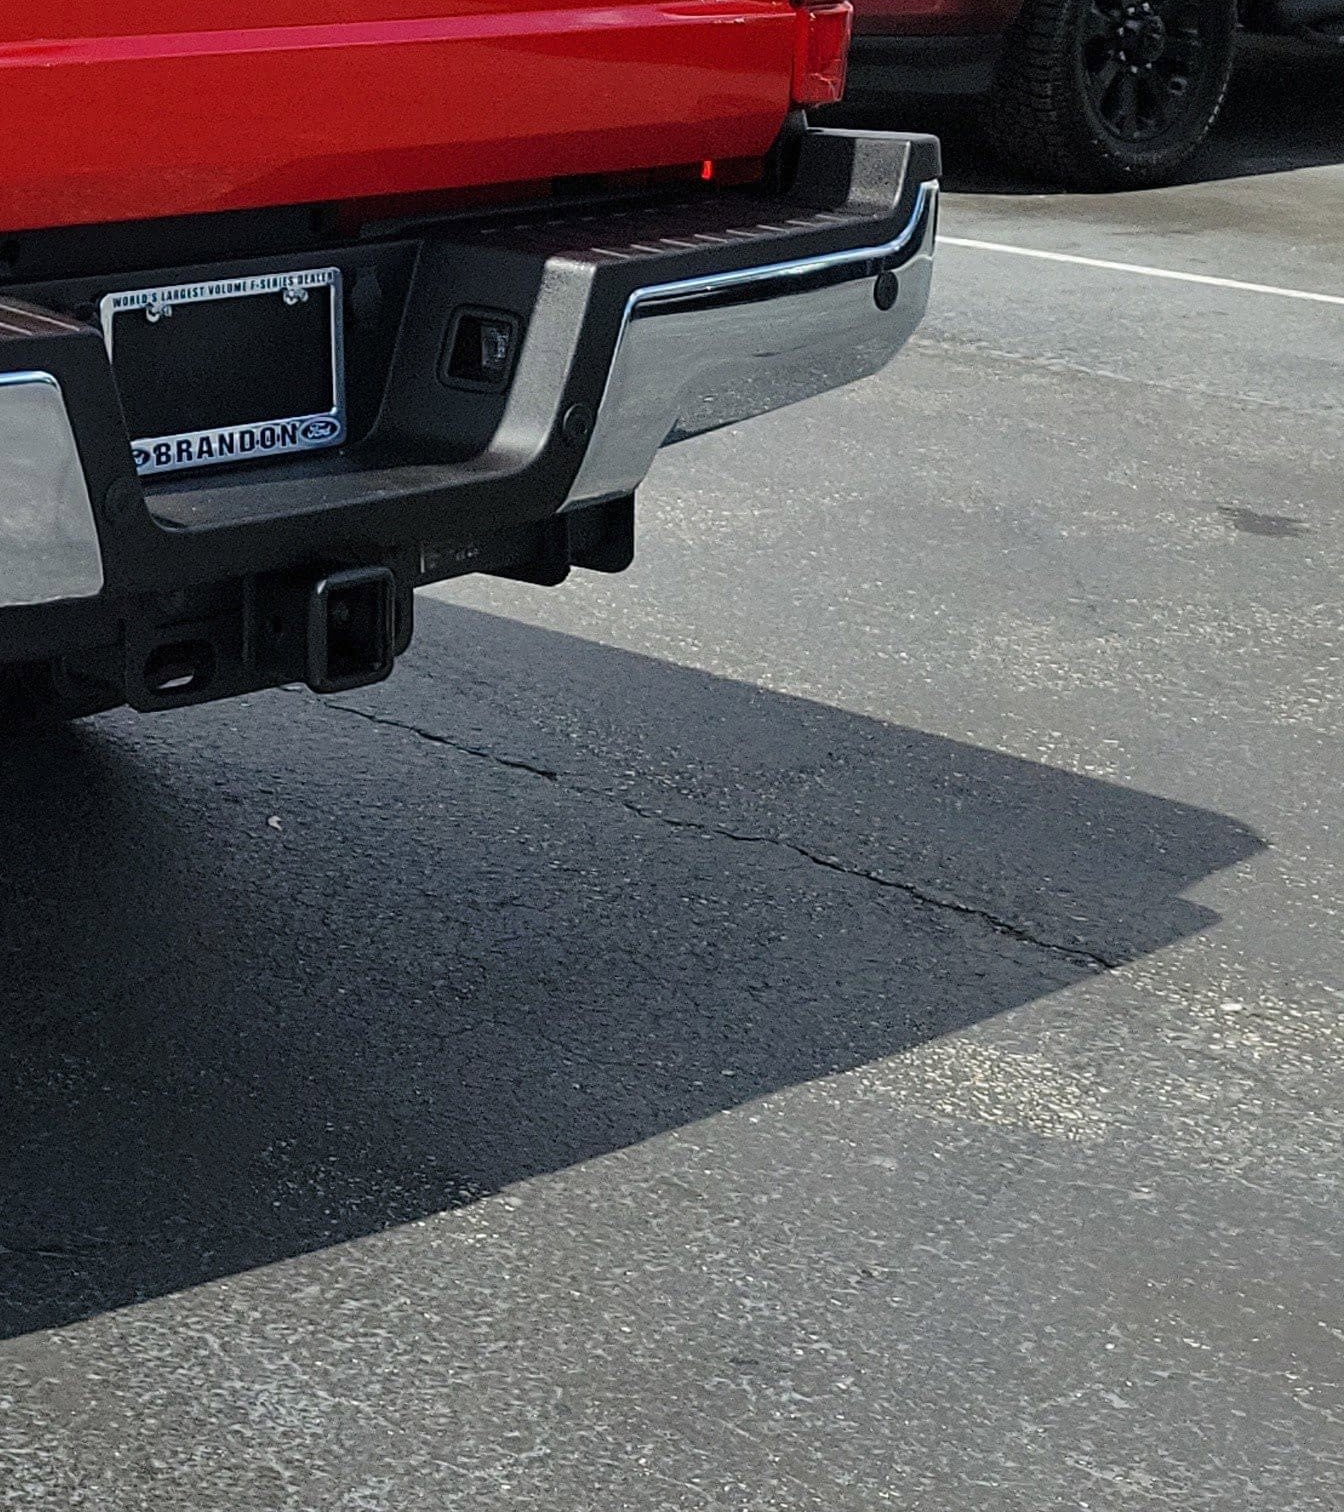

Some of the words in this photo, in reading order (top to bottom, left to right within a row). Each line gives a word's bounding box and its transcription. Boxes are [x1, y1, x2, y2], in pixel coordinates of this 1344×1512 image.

[112, 292, 158, 308] WORLD'S
[160, 286, 205, 302] LARGEST
[208, 281, 248, 297] VOLUME
[250, 275, 294, 292] F-SERIES
[297, 271, 334, 286] DEALER
[153, 422, 299, 466] BRANDON
